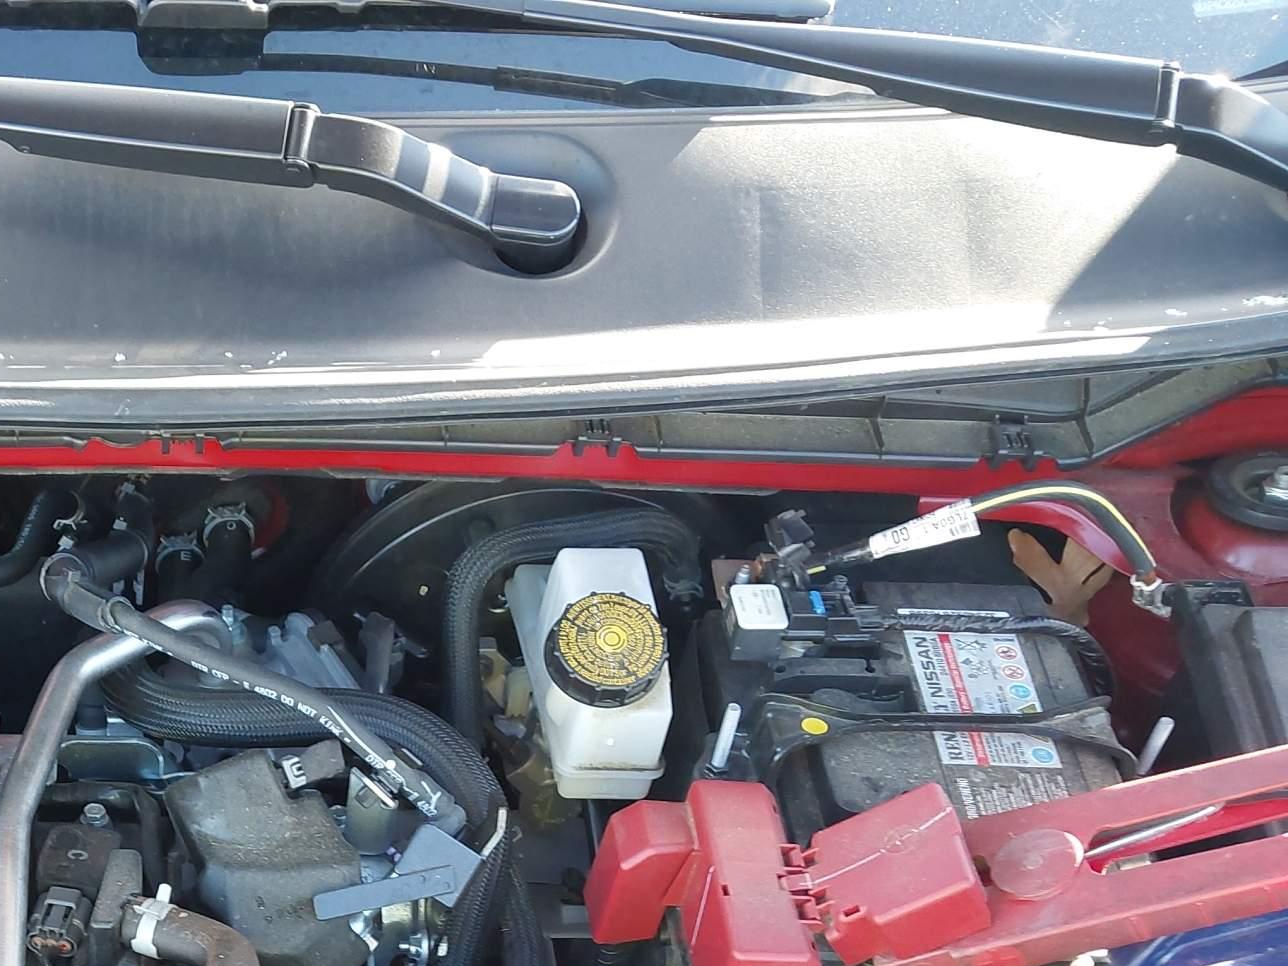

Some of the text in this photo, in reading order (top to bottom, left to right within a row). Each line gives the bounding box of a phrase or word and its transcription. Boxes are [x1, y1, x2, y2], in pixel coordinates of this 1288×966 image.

[913, 636, 947, 699] NISSAN
[280, 693, 294, 708] DO
[297, 701, 318, 718] NOT
